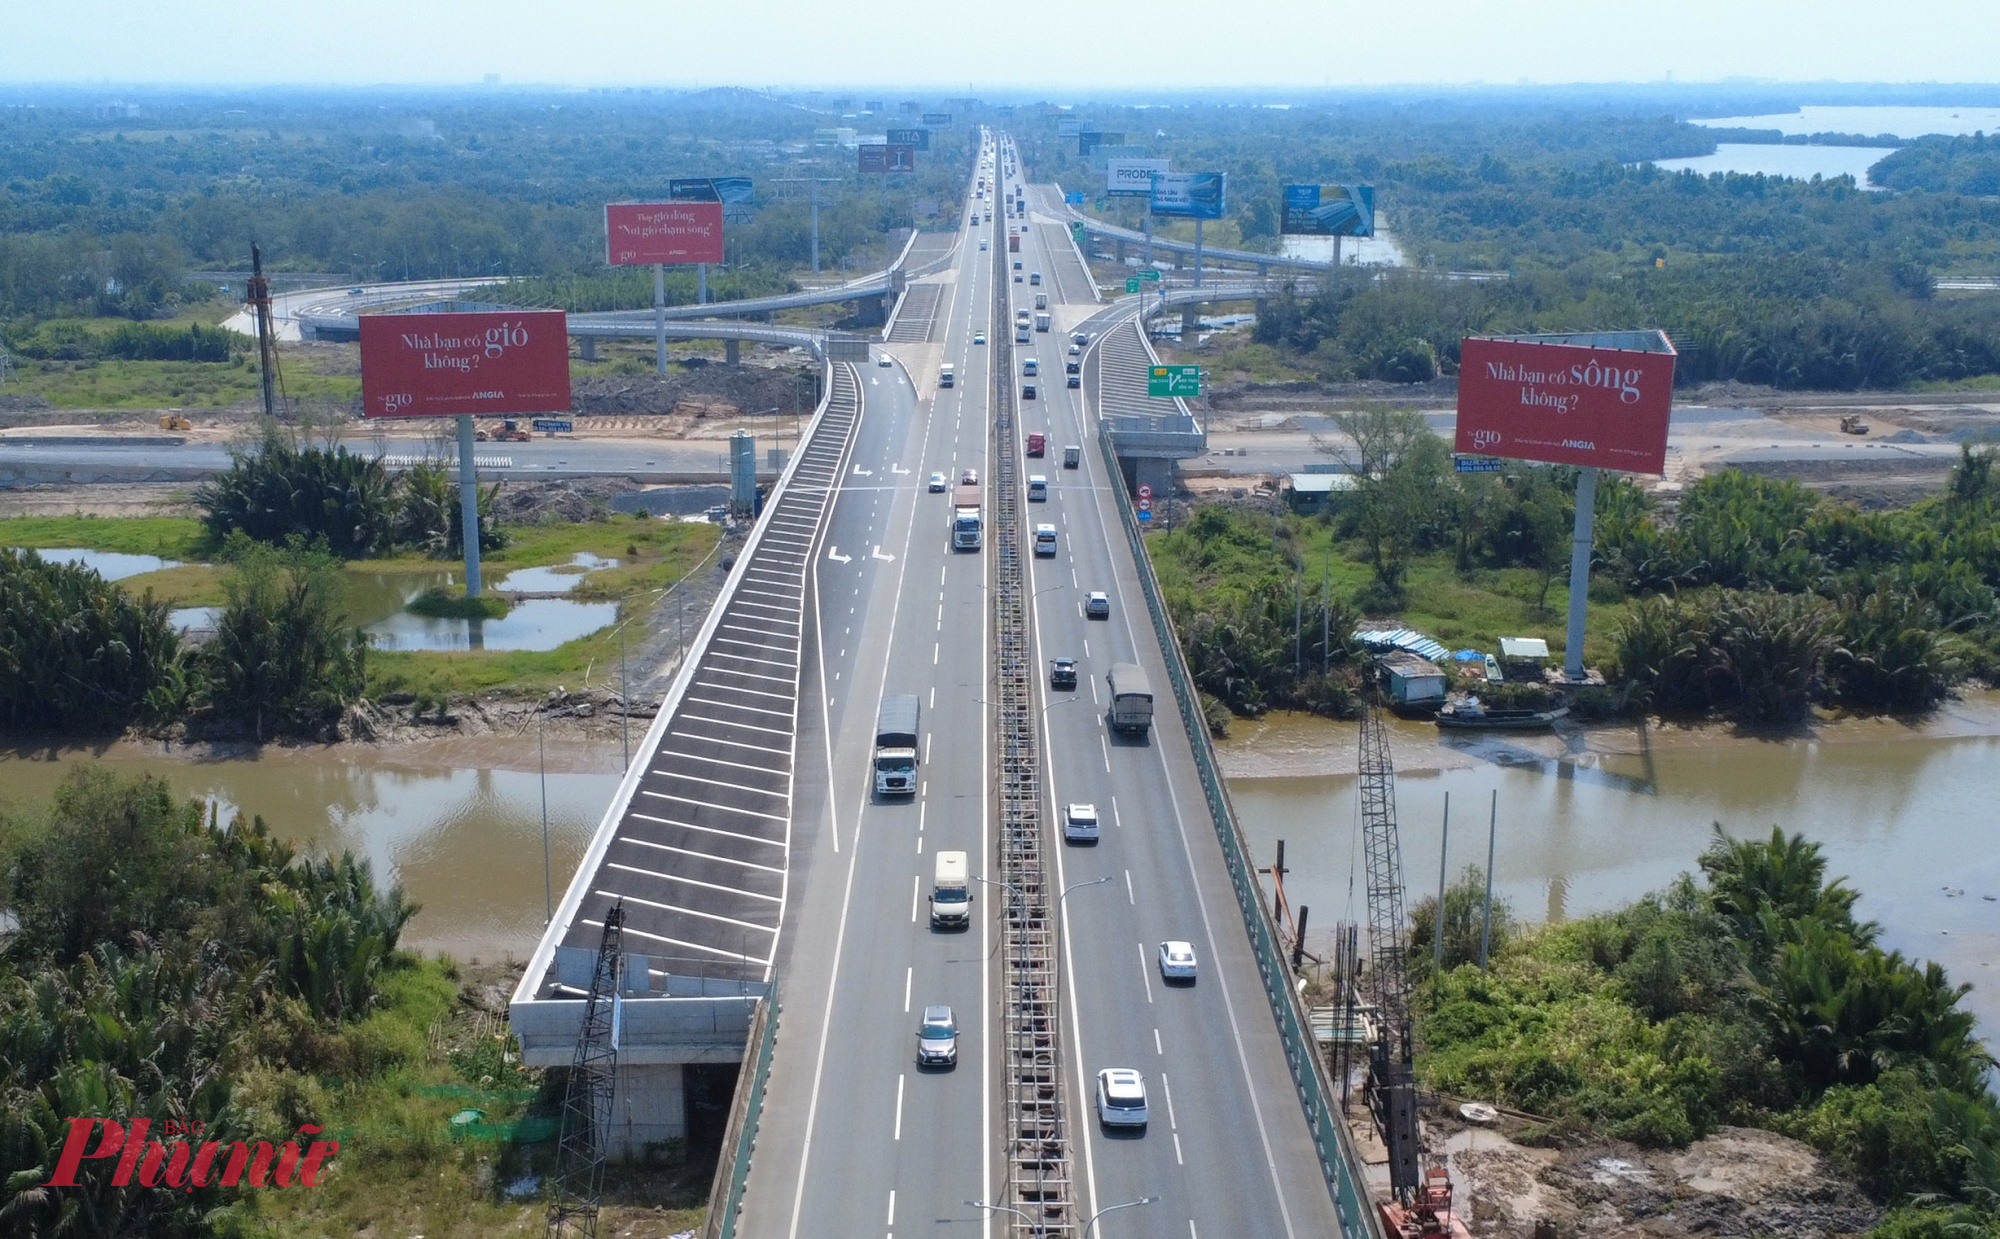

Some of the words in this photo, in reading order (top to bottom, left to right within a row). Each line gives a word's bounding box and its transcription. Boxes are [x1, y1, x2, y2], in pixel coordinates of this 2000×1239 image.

[401, 333, 431, 350] Nhà
[435, 332, 461, 351] bạn
[464, 334, 481, 348] có
[485, 321, 528, 358] gió
[1485, 361, 1516, 381] Nhà
[1518, 364, 1545, 386] bạn
[1548, 369, 1566, 385] có
[1569, 358, 1643, 404] sông
